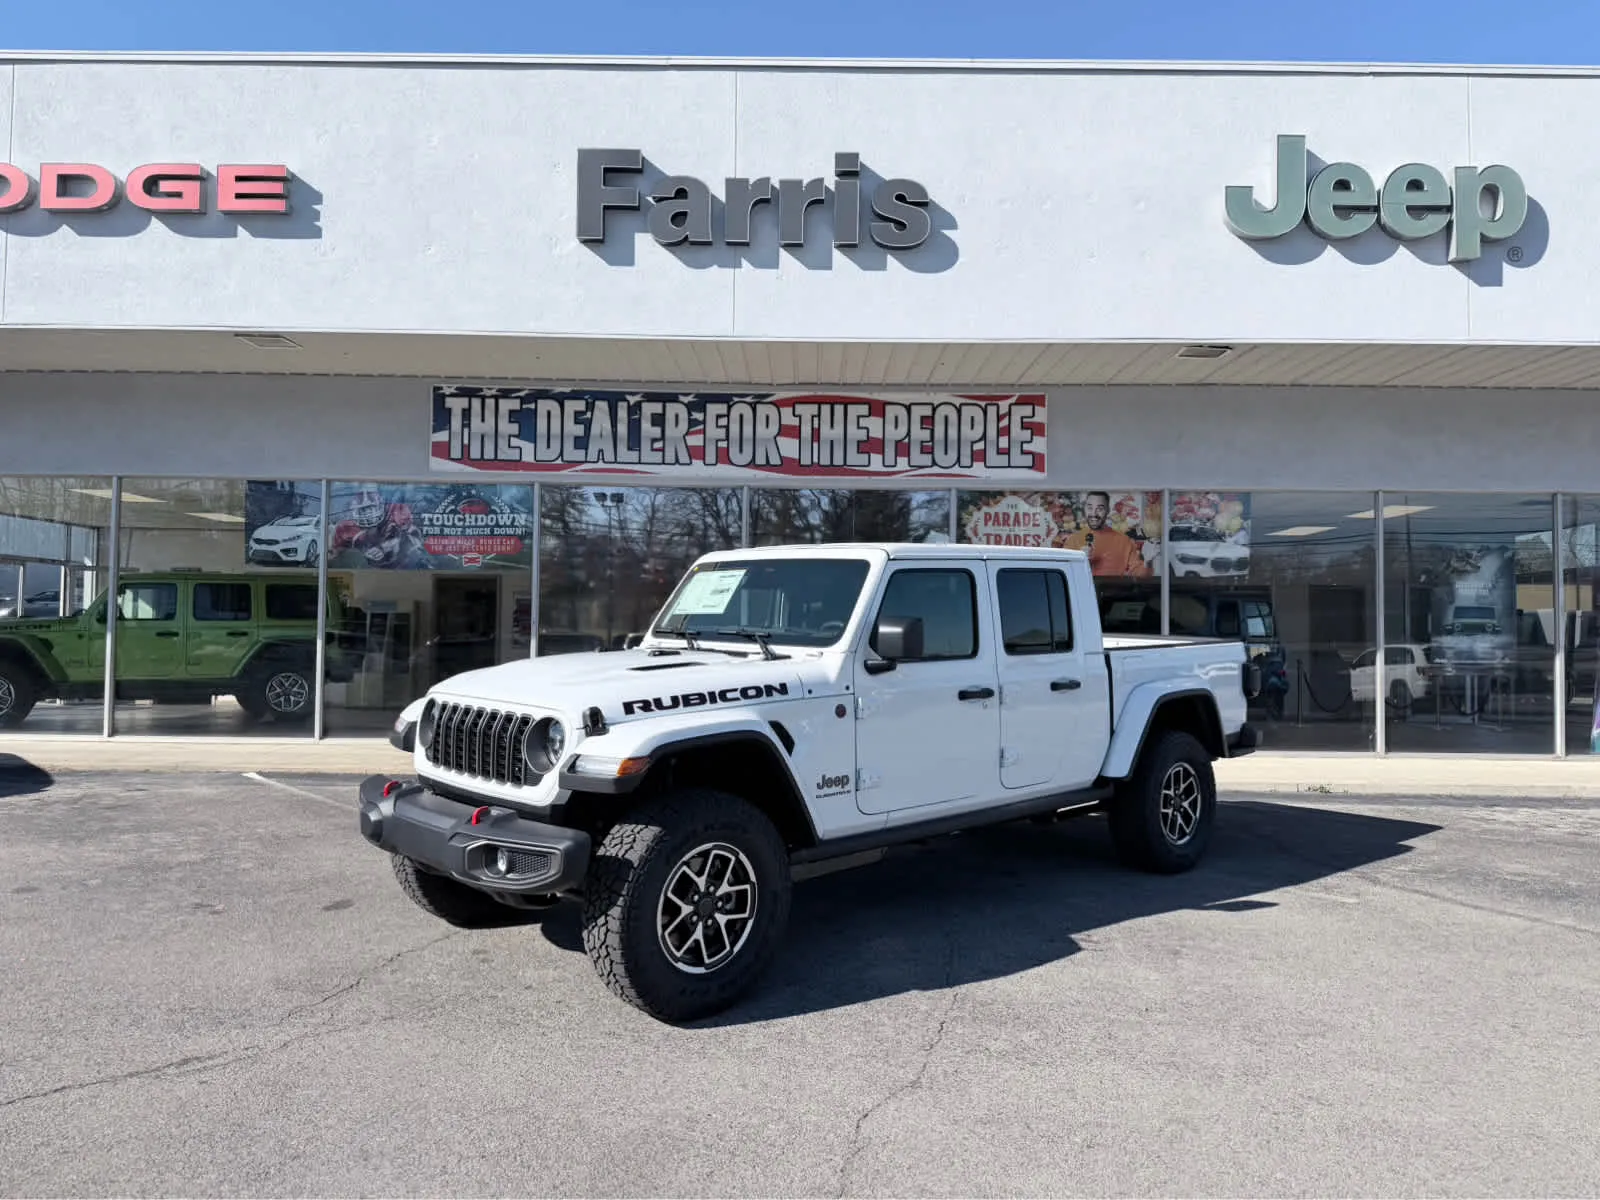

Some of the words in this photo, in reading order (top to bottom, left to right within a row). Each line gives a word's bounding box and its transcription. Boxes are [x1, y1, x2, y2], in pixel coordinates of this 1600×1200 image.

[576, 147, 933, 249] Farris
[1224, 133, 1528, 262] Jeep
[445, 395, 522, 461] THE
[534, 398, 692, 465] DEALER
[703, 401, 782, 466] FOR
[794, 402, 871, 467] THE
[882, 402, 1035, 469] PEOPLE
[421, 513, 527, 526] TOUCHDOWN
[983, 511, 1041, 527] PARADE
[423, 527, 441, 535] FOR
[443, 527, 461, 536] NOT
[465, 527, 491, 536] MUCH
[983, 533, 1042, 547] TRADES
[622, 682, 789, 715] RUBICON
[816, 773, 850, 790] Jeep
